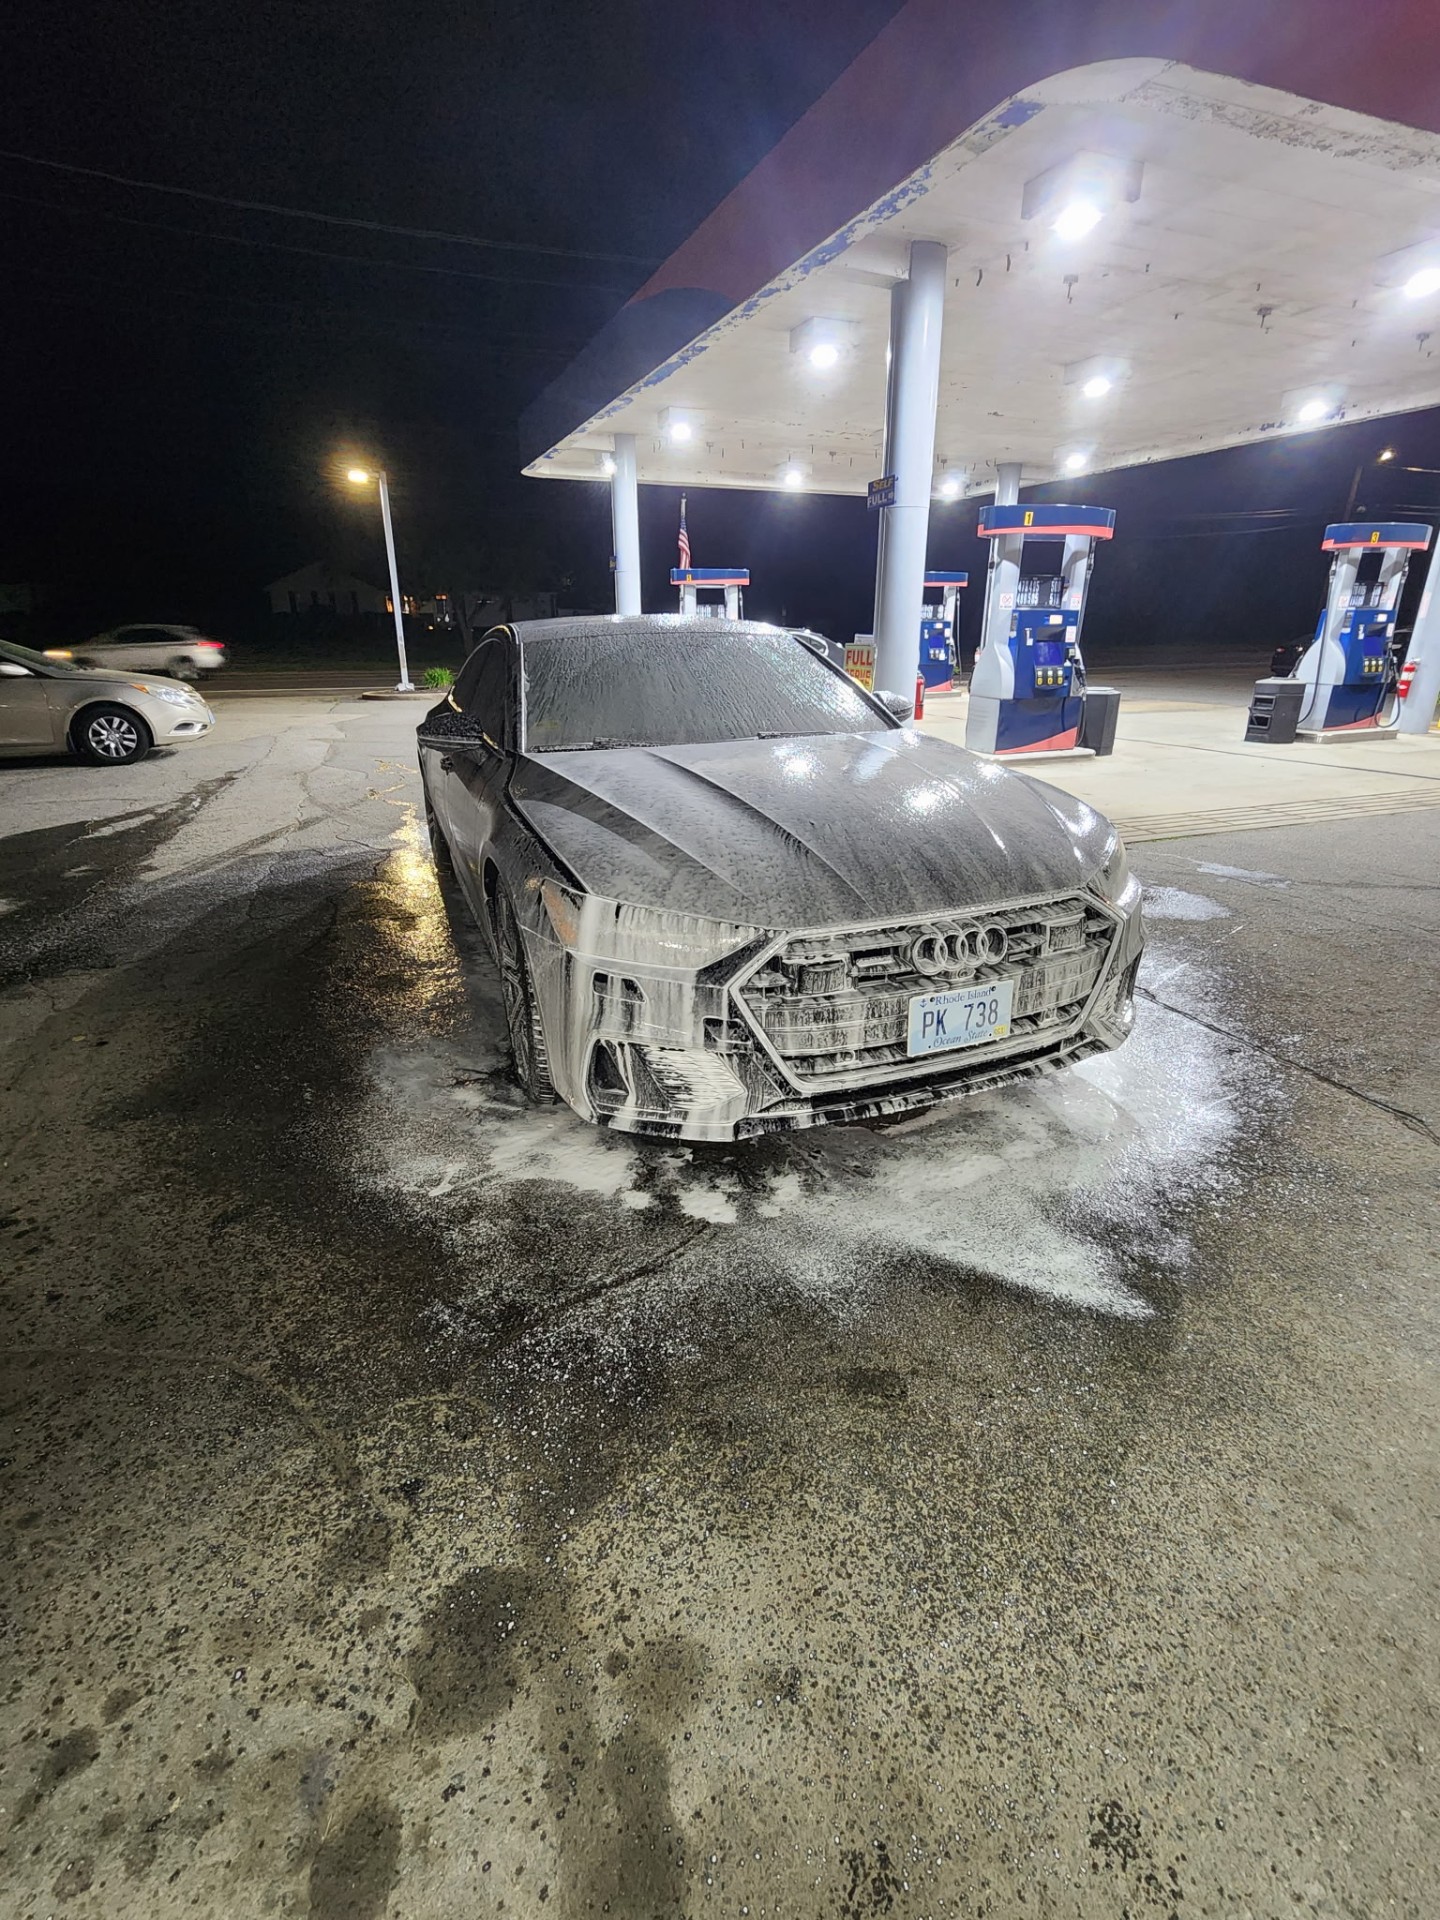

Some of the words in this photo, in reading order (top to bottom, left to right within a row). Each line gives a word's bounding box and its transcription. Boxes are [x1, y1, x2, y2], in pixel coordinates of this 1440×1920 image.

[867, 492, 888, 509] FULL
[846, 650, 873, 666] FULL
[935, 992, 964, 1006] Rhode
[967, 987, 992, 999] Island
[922, 1008, 948, 1039] PK
[964, 999, 999, 1031] 738
[933, 1036, 962, 1048] Ocean
[964, 1030, 988, 1043] State
